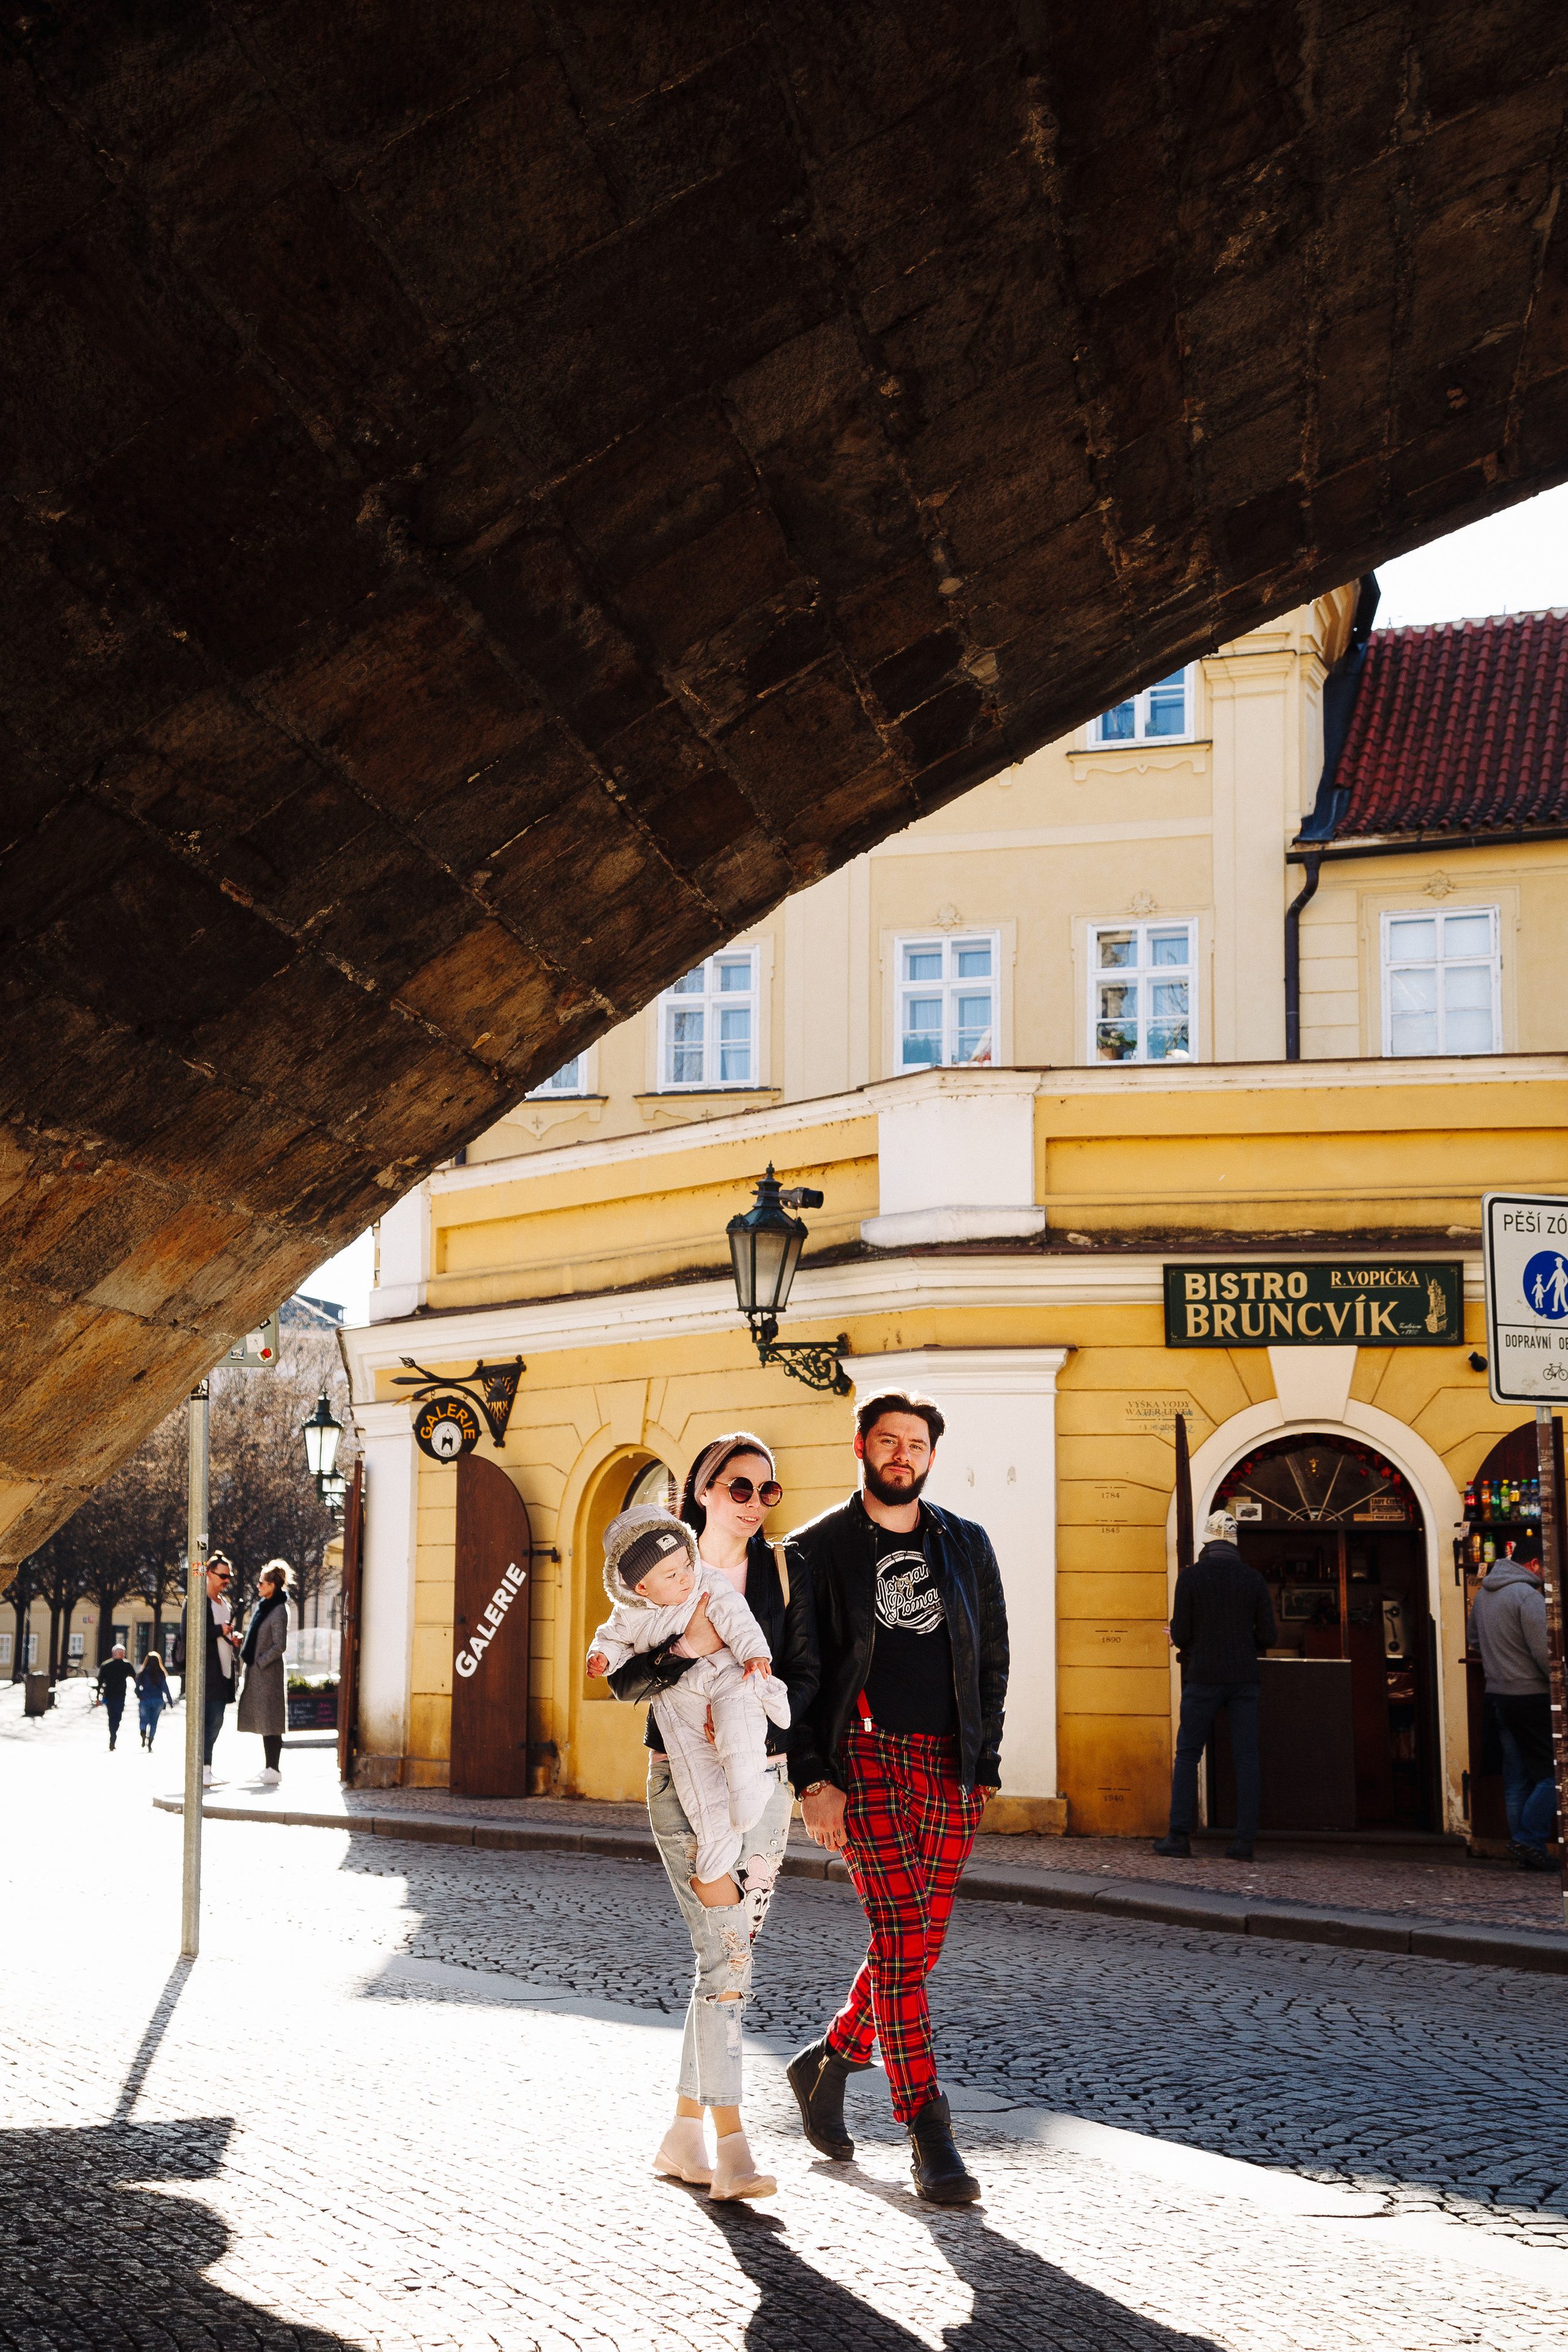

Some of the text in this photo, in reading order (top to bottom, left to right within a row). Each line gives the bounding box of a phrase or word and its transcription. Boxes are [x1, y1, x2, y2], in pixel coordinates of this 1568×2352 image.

[1504, 1210, 1541, 1233] PĚŠÍ
[1184, 1271, 1308, 1301] BISTRO
[1185, 1294, 1400, 1339] BRUNCVÍK
[1506, 1333, 1551, 1350] DOPRAVNÍ
[1128, 1400, 1160, 1408] VÝŠKA
[420, 1403, 475, 1440] GALERIE
[454, 1562, 527, 1678] GALERIE
